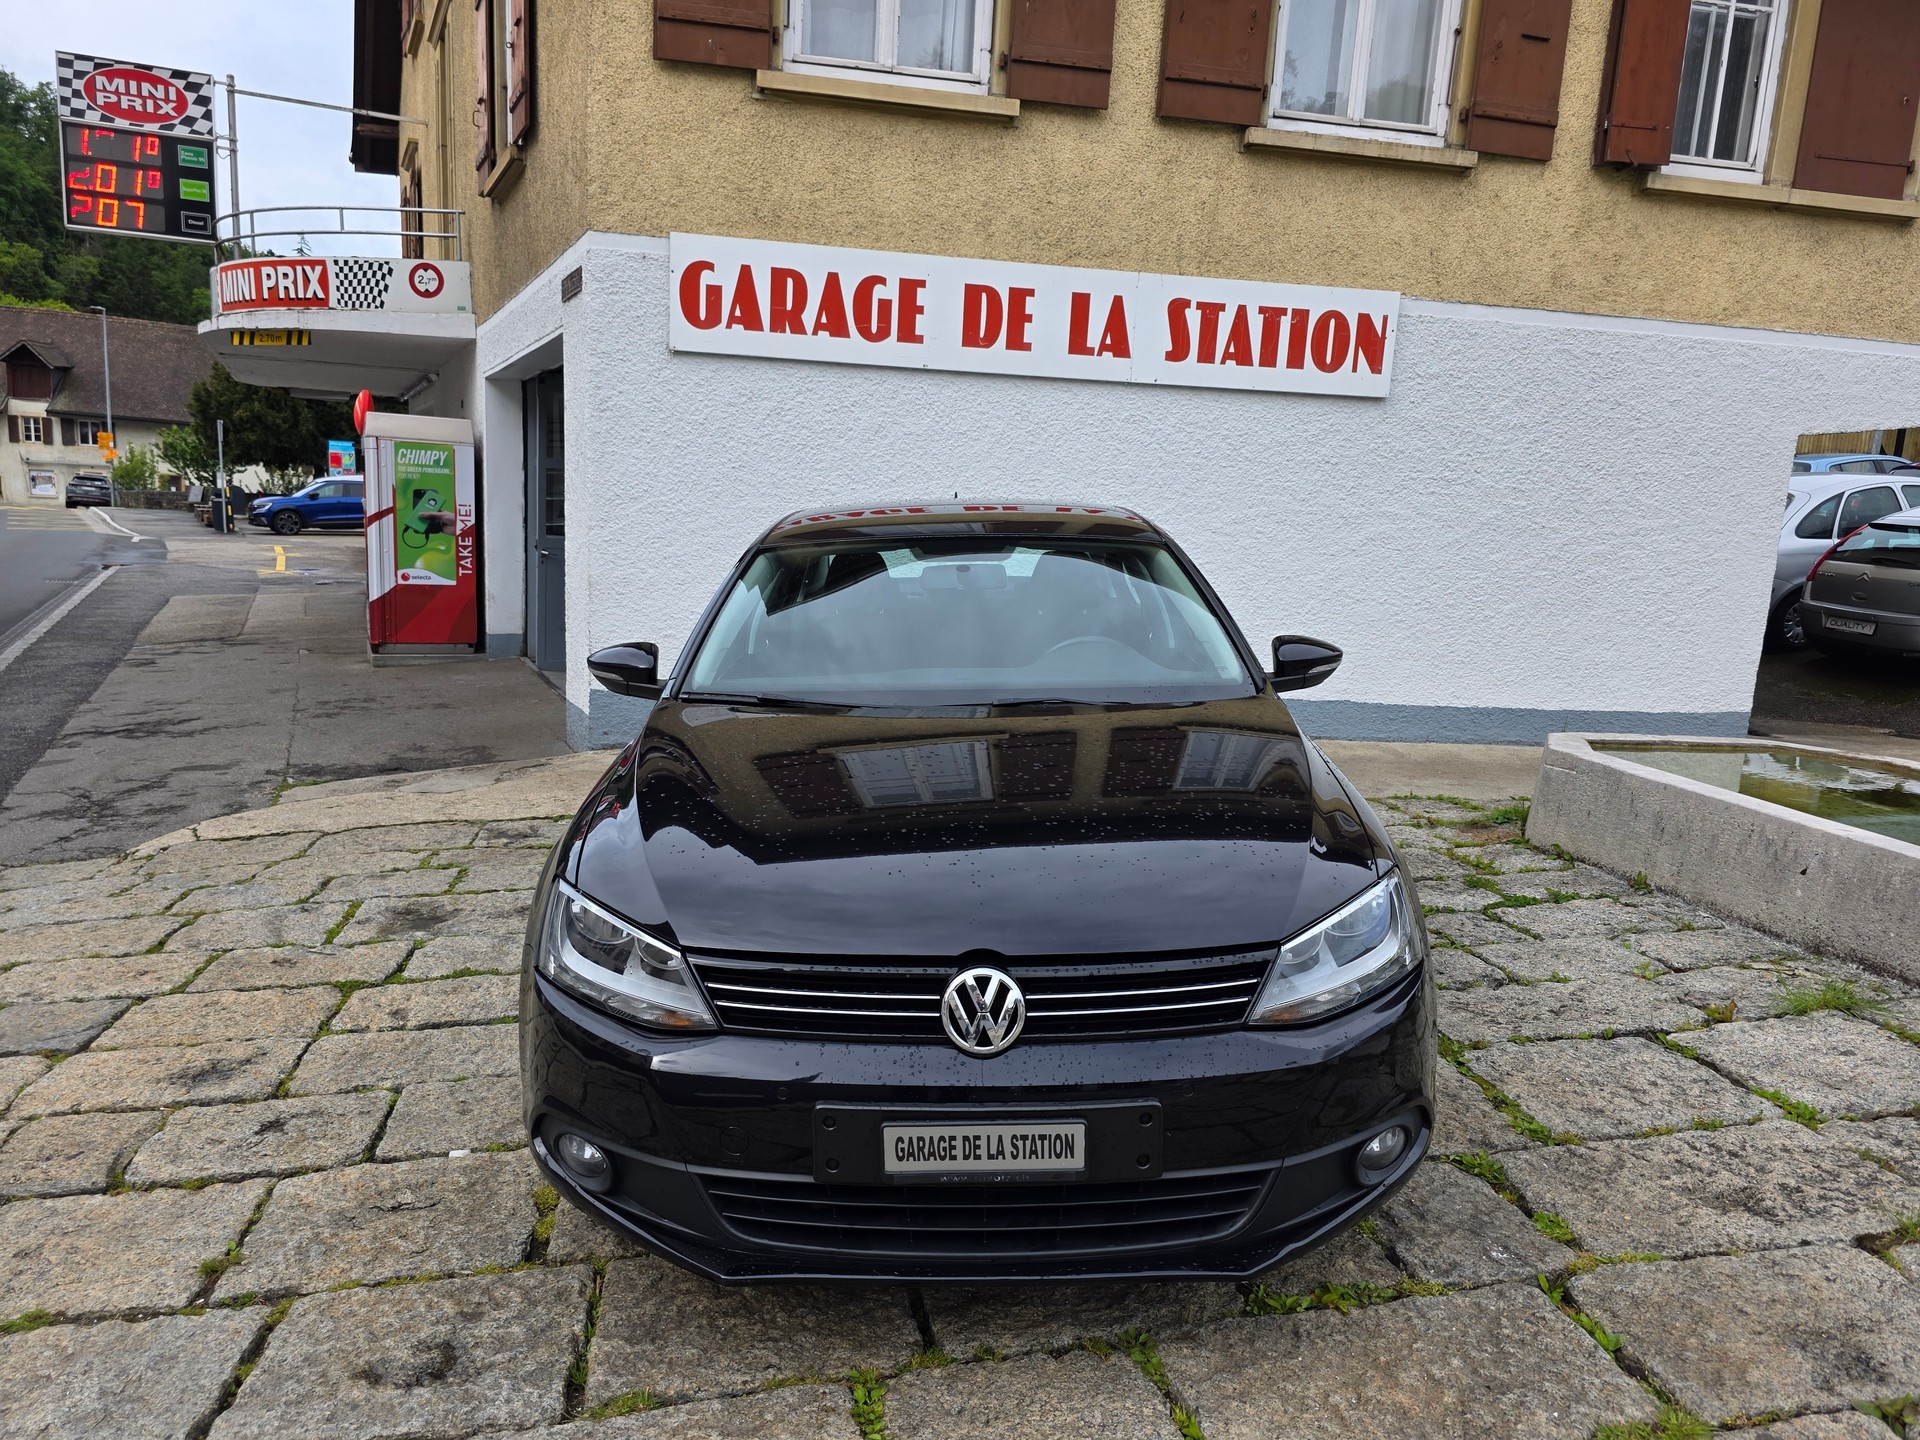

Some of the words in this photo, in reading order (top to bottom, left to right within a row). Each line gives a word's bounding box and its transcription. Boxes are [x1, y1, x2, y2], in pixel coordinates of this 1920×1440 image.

[95, 75, 177, 101] MINI
[96, 91, 178, 117] PRIX
[221, 267, 256, 304] MINI
[261, 265, 326, 300] PRIX
[679, 260, 927, 344] GARAGE
[962, 283, 1036, 352] DE
[1068, 292, 1132, 359] LA
[1164, 297, 1389, 375] STATION
[397, 448, 449, 466] CHIMPY
[458, 503, 472, 533] ME!
[458, 536, 473, 577] TAKE
[894, 1135, 958, 1162] GARAGE
[962, 1135, 982, 1160] DE
[986, 1134, 1006, 1160] LA
[1010, 1133, 1075, 1160] STATION
